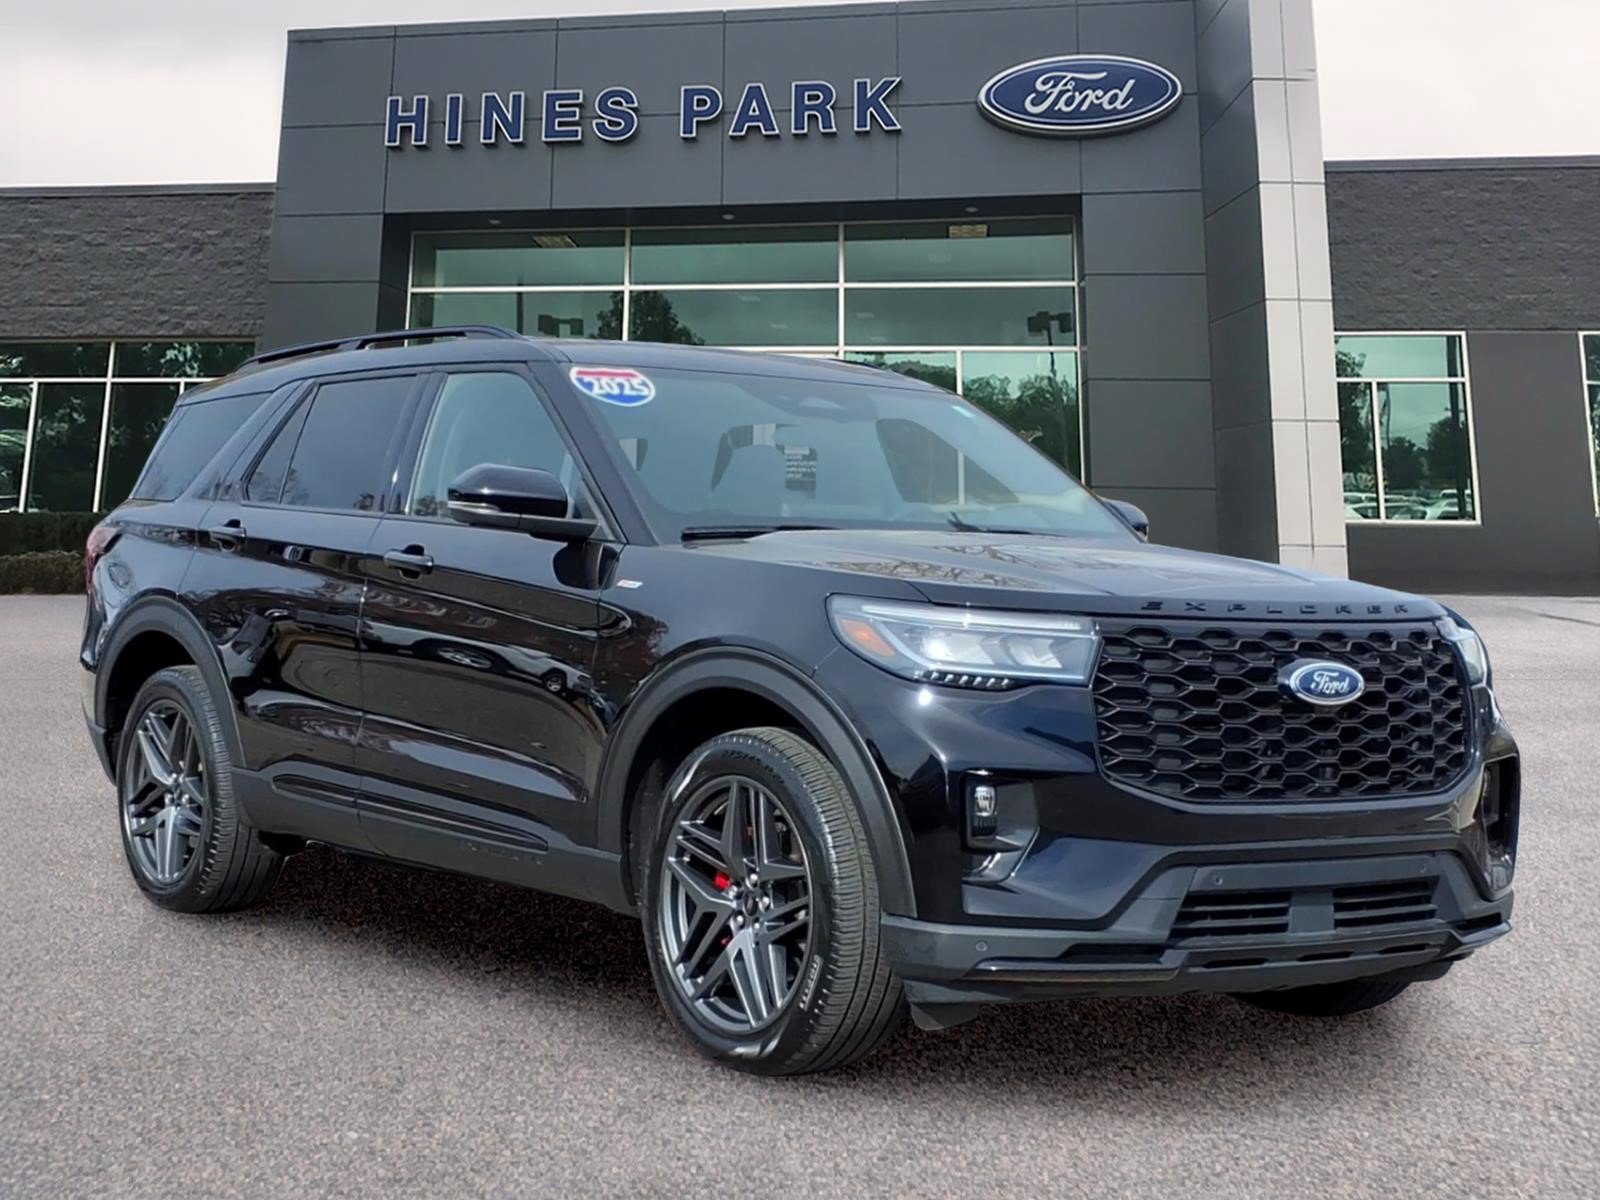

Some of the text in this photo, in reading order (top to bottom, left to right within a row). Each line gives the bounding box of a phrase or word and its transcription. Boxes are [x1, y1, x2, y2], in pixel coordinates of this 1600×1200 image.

[1024, 71, 1136, 114] Ford
[385, 77, 902, 147] HINES PARK
[582, 377, 650, 396] 2025
[1140, 601, 1408, 614] EXPLORER
[1310, 670, 1350, 694] Ford
